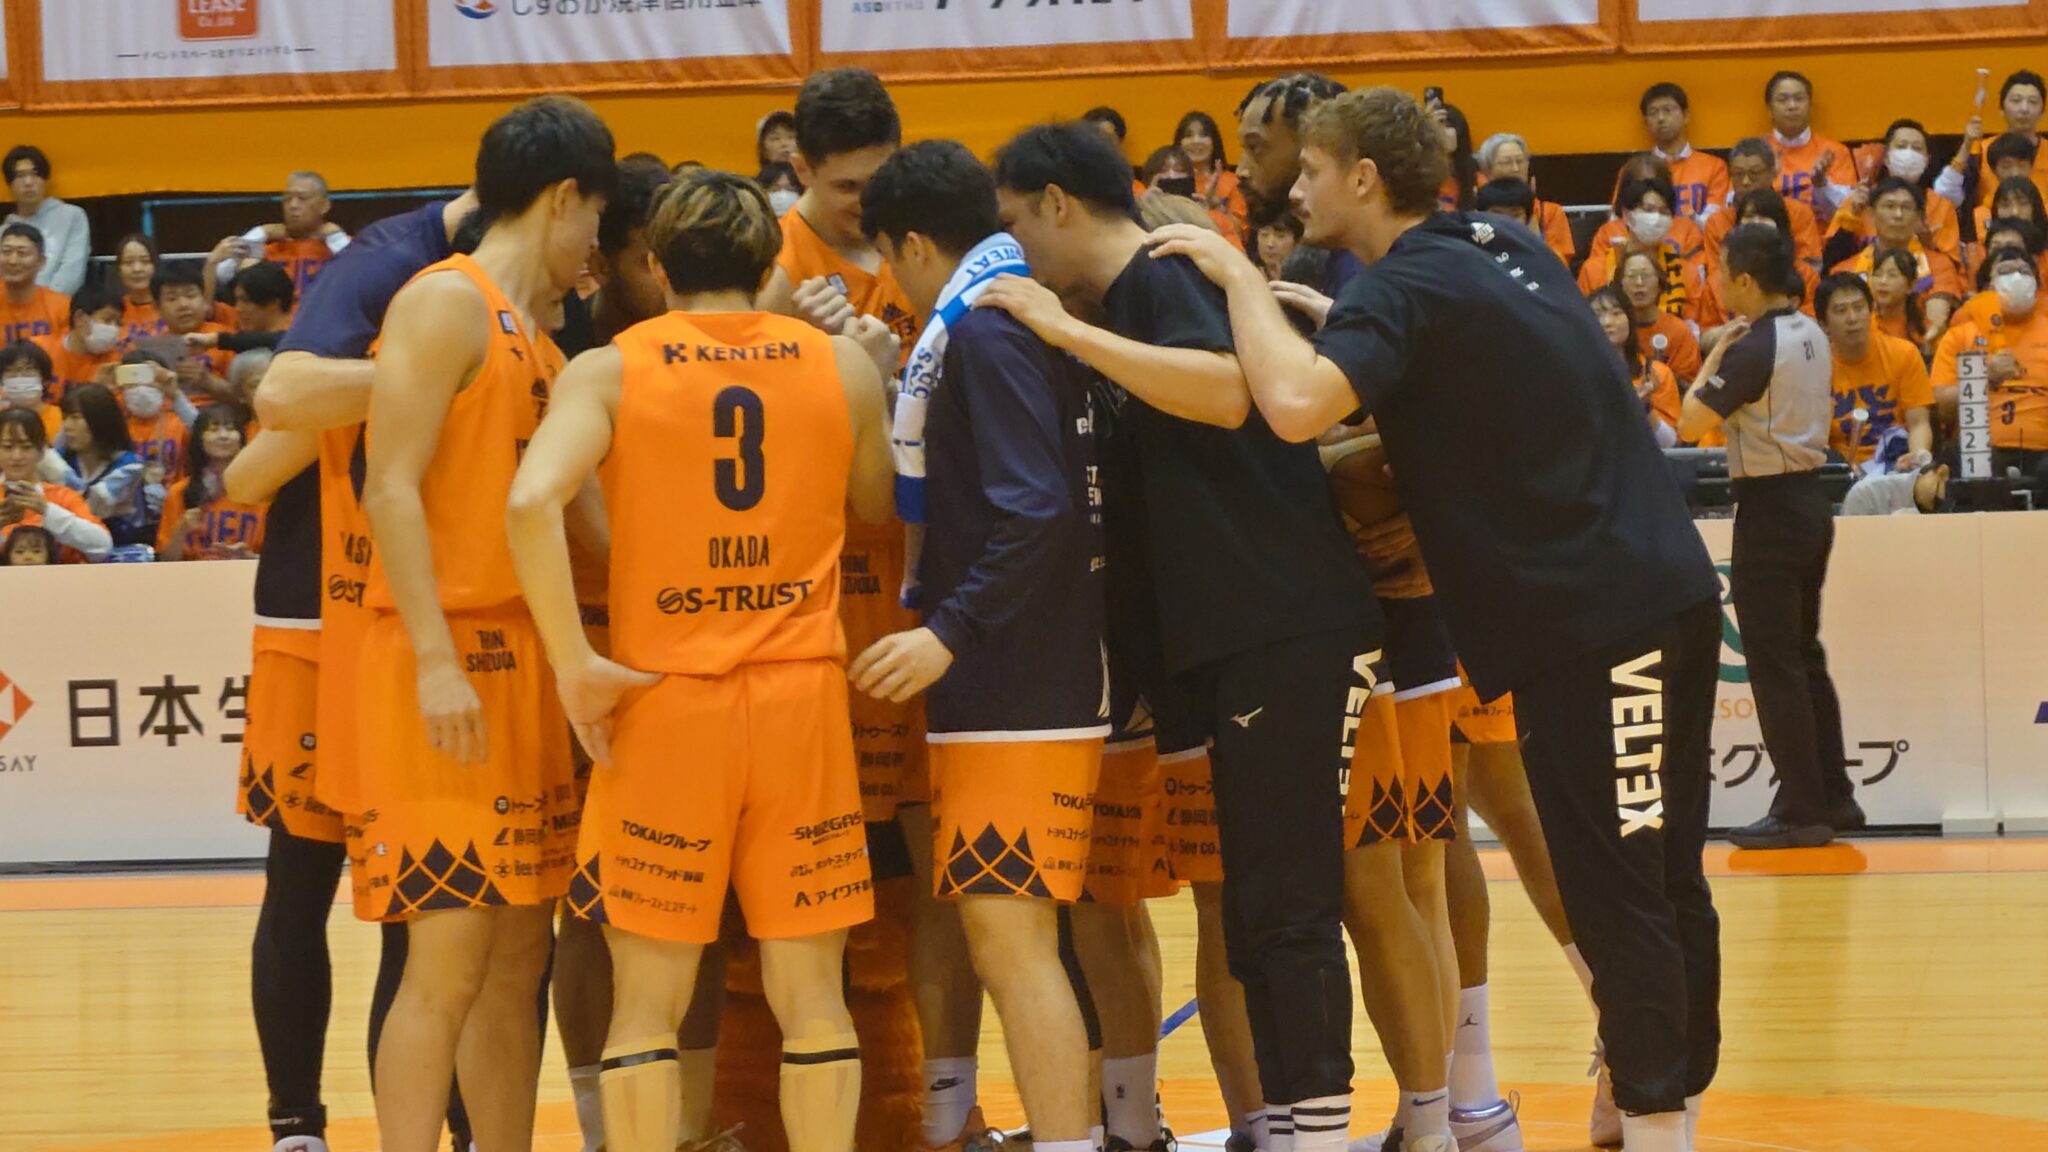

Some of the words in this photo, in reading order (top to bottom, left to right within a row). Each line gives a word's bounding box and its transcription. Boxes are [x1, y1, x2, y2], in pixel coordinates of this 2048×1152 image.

[696, 342, 800, 362] KENTEM
[1962, 358, 1973, 375] 5
[1963, 382, 1973, 399] 4
[1964, 407, 1975, 425] 3
[713, 385, 765, 511] 3
[1965, 432, 1976, 449] 2
[1967, 457, 1975, 474] 1
[708, 535, 770, 568] OKADA
[684, 580, 813, 613] S-TRUST
[1611, 650, 1664, 838] VELTEX
[622, 819, 712, 852] TOKAIグループ
